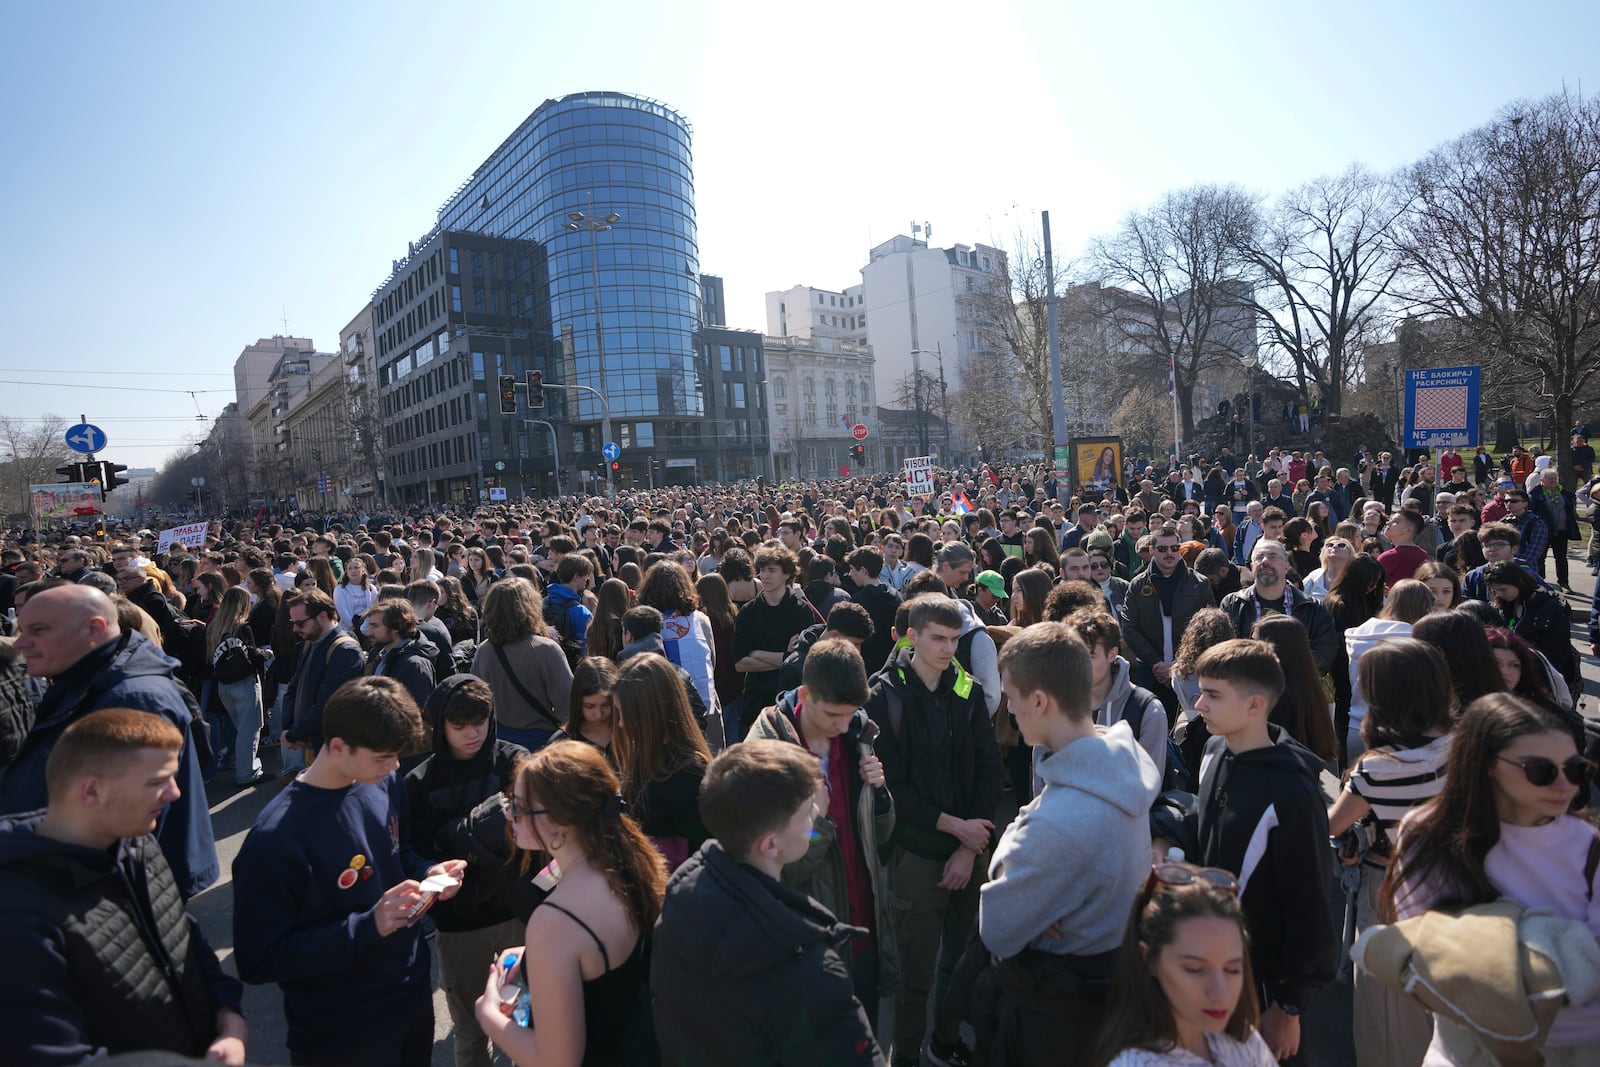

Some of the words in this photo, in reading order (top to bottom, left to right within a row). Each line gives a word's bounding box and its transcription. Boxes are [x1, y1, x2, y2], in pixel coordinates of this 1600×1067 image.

[1412, 371, 1427, 380] НЕ
[1416, 378, 1467, 386] РАСКРСНИЦУ
[1412, 431, 1427, 439] NE
[905, 458, 930, 468] VISOKA
[909, 470, 929, 483] ICT
[173, 525, 205, 537] ПРАВДУ
